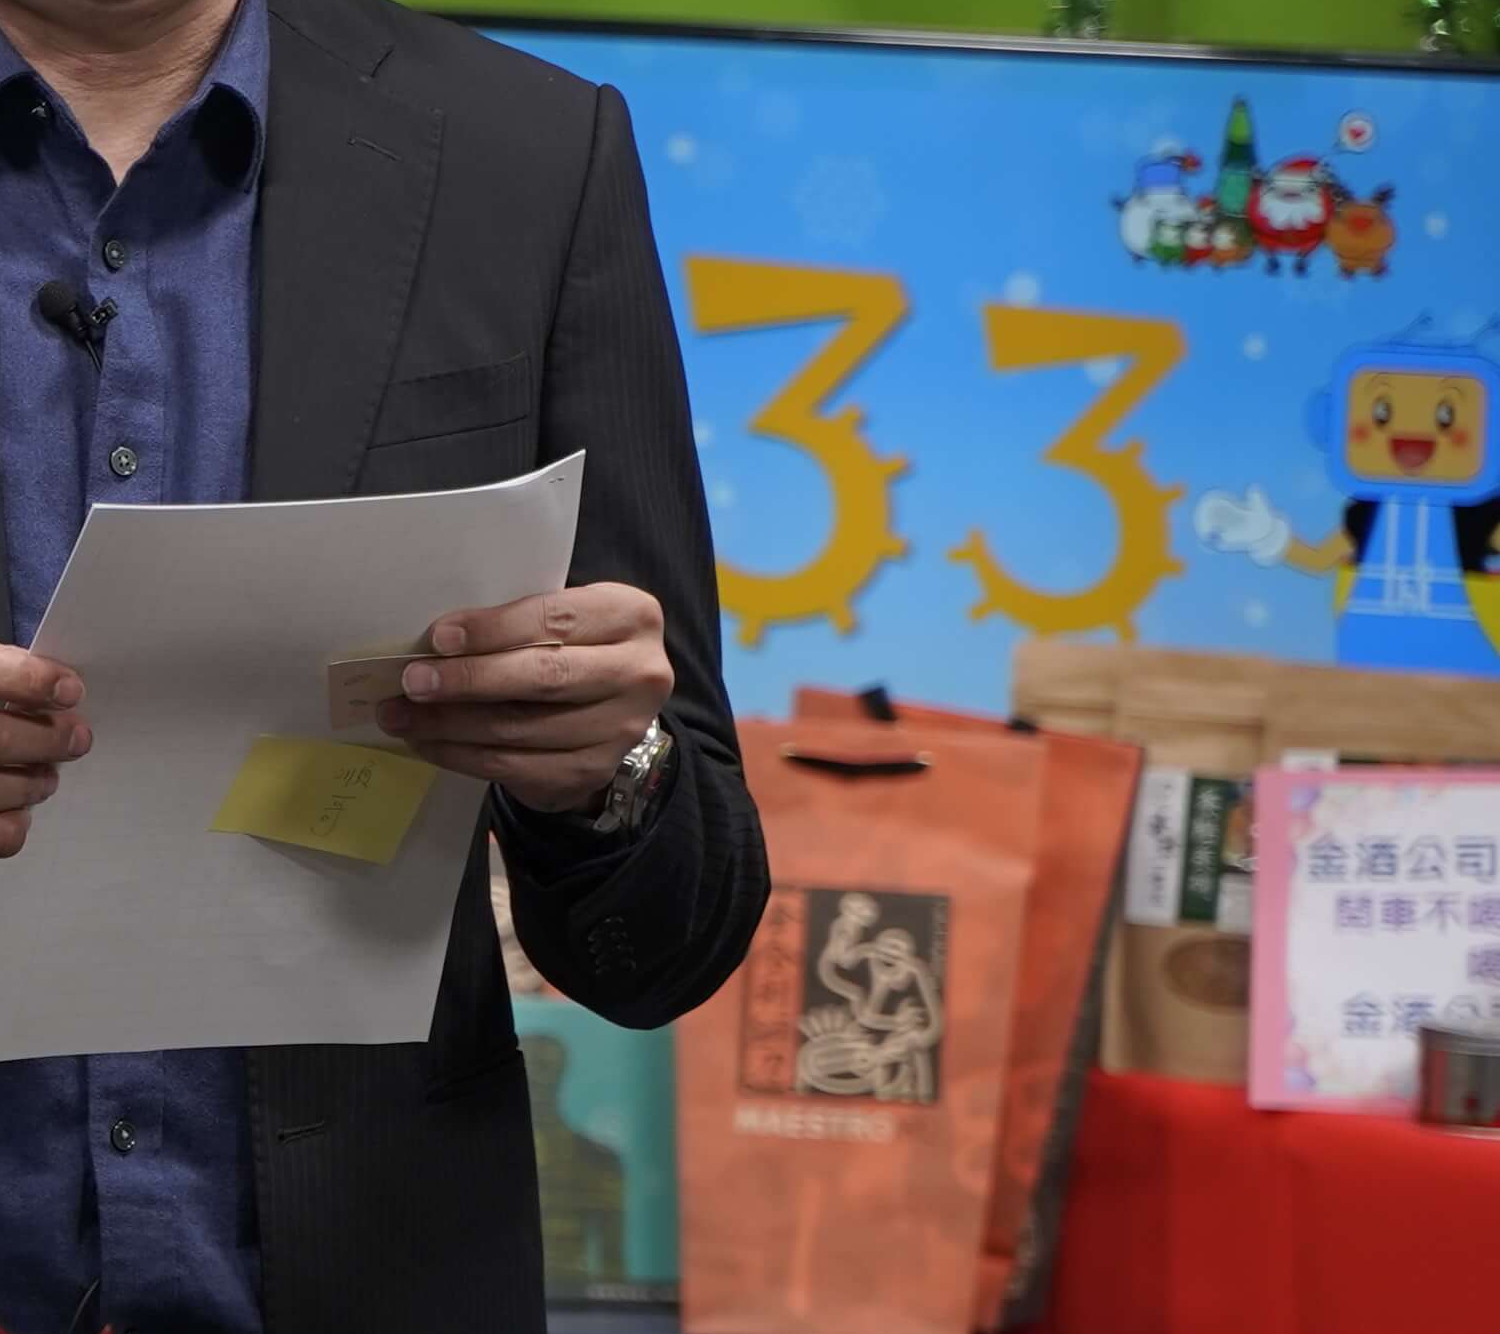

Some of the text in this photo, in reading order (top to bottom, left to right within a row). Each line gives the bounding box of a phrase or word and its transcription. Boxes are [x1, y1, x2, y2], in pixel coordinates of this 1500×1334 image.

[682, 254, 1190, 649] 33
[1307, 835, 1499, 886] 金酒公司
[733, 1104, 895, 1141] MAESTRO
